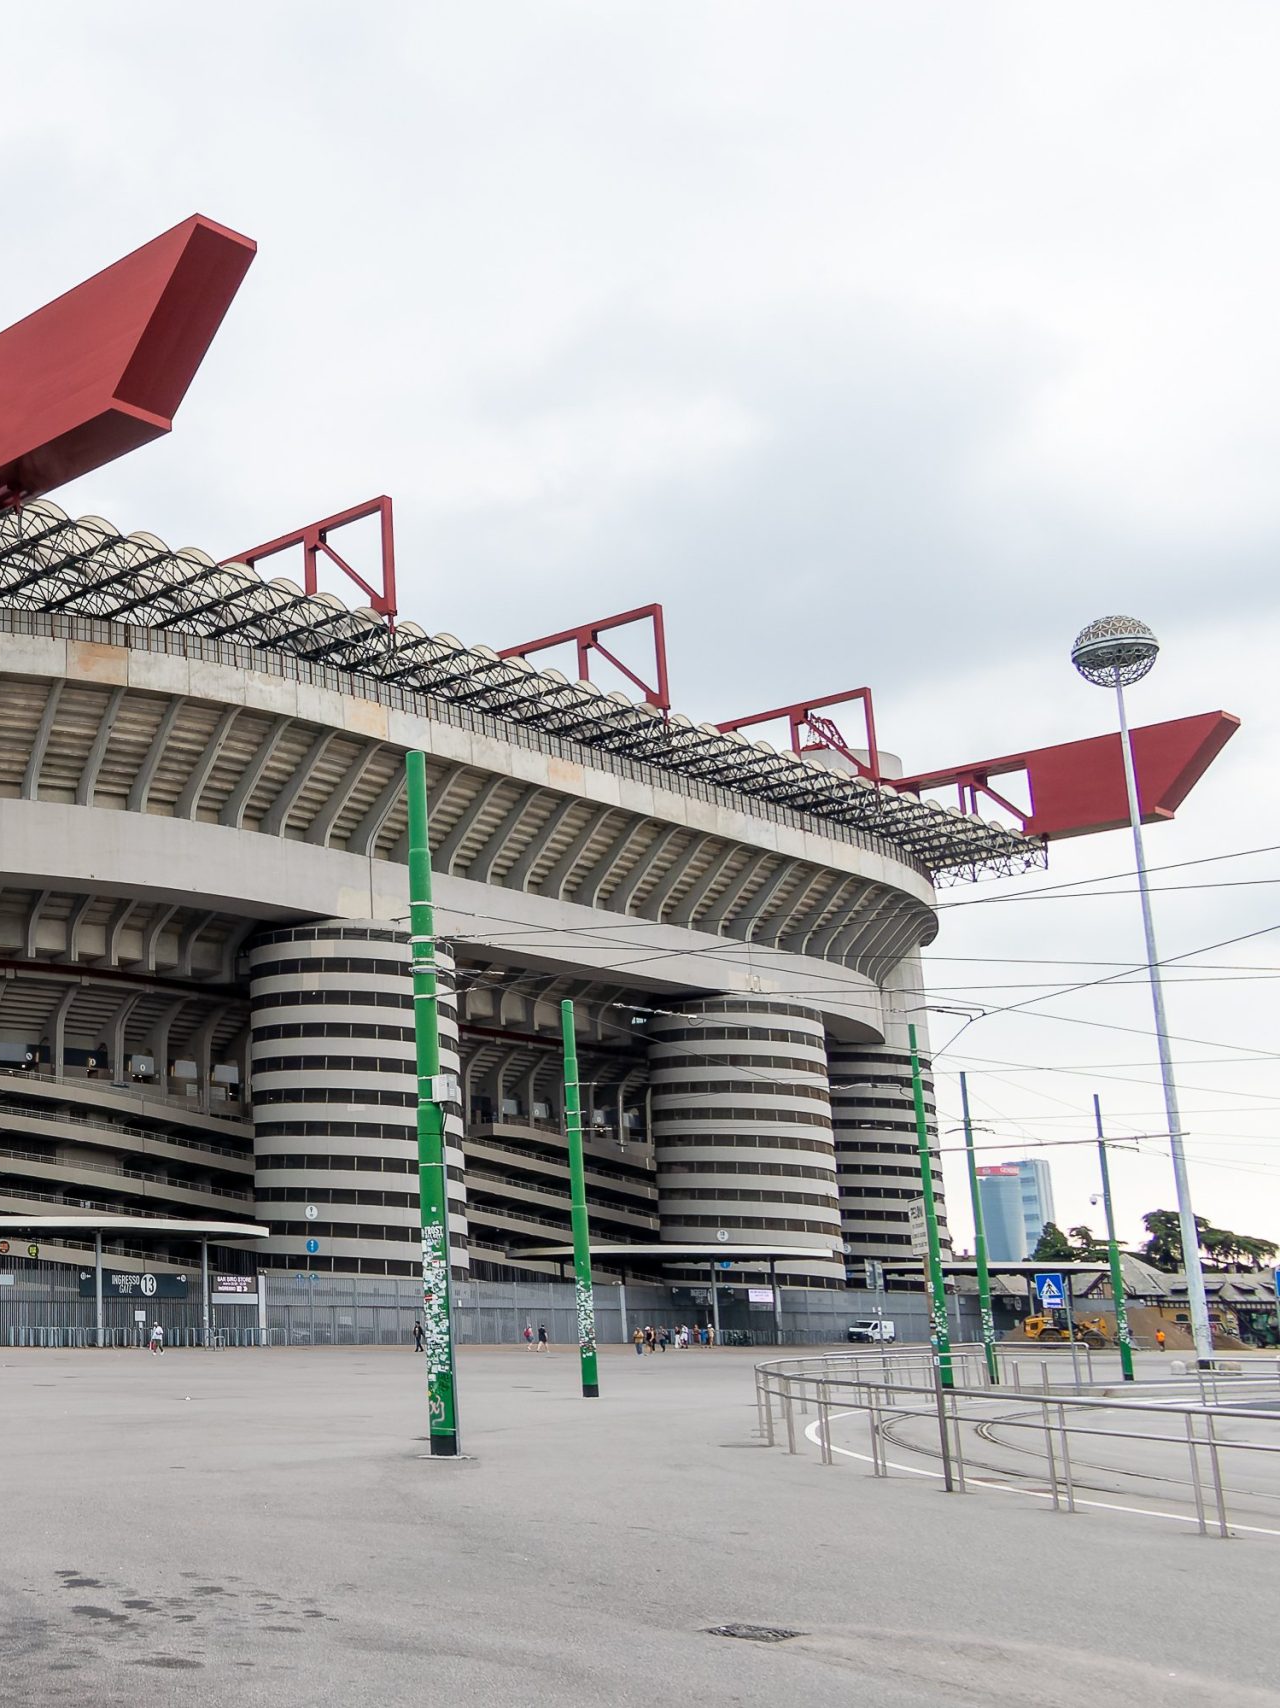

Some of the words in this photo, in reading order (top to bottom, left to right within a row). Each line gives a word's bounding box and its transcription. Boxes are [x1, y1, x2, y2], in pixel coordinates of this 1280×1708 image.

[111, 1274, 140, 1285] INGRESSO
[144, 1276, 154, 1293] 13
[119, 1284, 132, 1294] GATE
